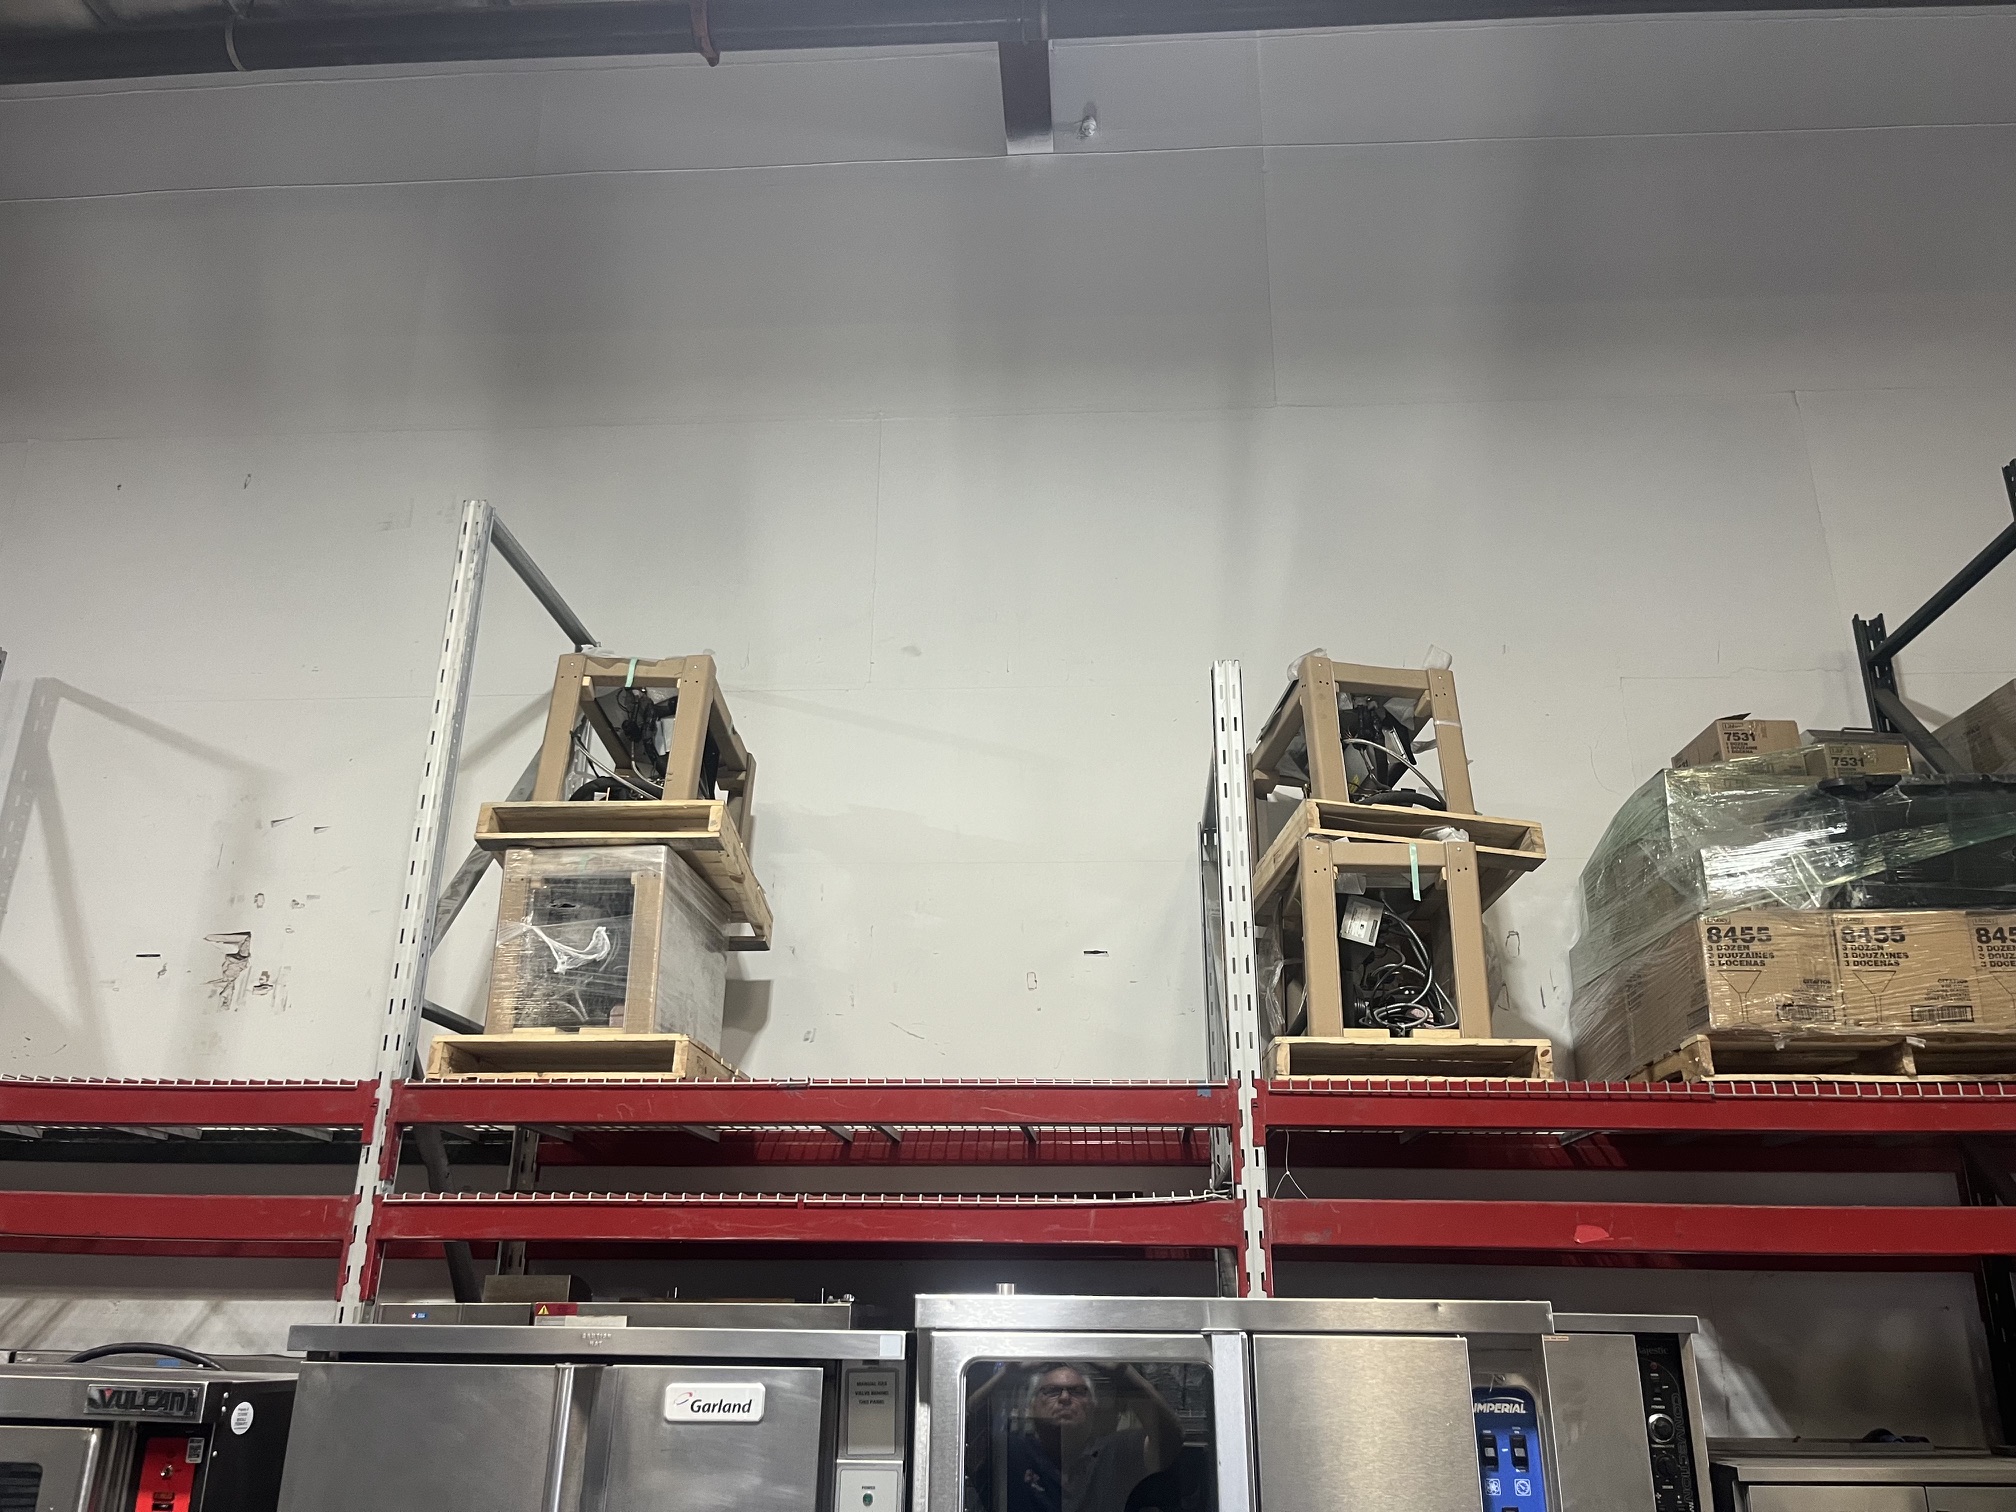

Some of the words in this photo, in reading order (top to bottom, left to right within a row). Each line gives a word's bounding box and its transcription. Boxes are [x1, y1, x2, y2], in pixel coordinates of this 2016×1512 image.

[1723, 731, 1757, 742] 7531
[1830, 756, 1865, 767] 7531
[1706, 926, 1772, 944] 8455
[1841, 925, 1906, 944] 8455
[98, 1387, 188, 1412] VULCAN
[690, 1398, 753, 1414] Garland
[1472, 1402, 1527, 1414] IMPERIAL
